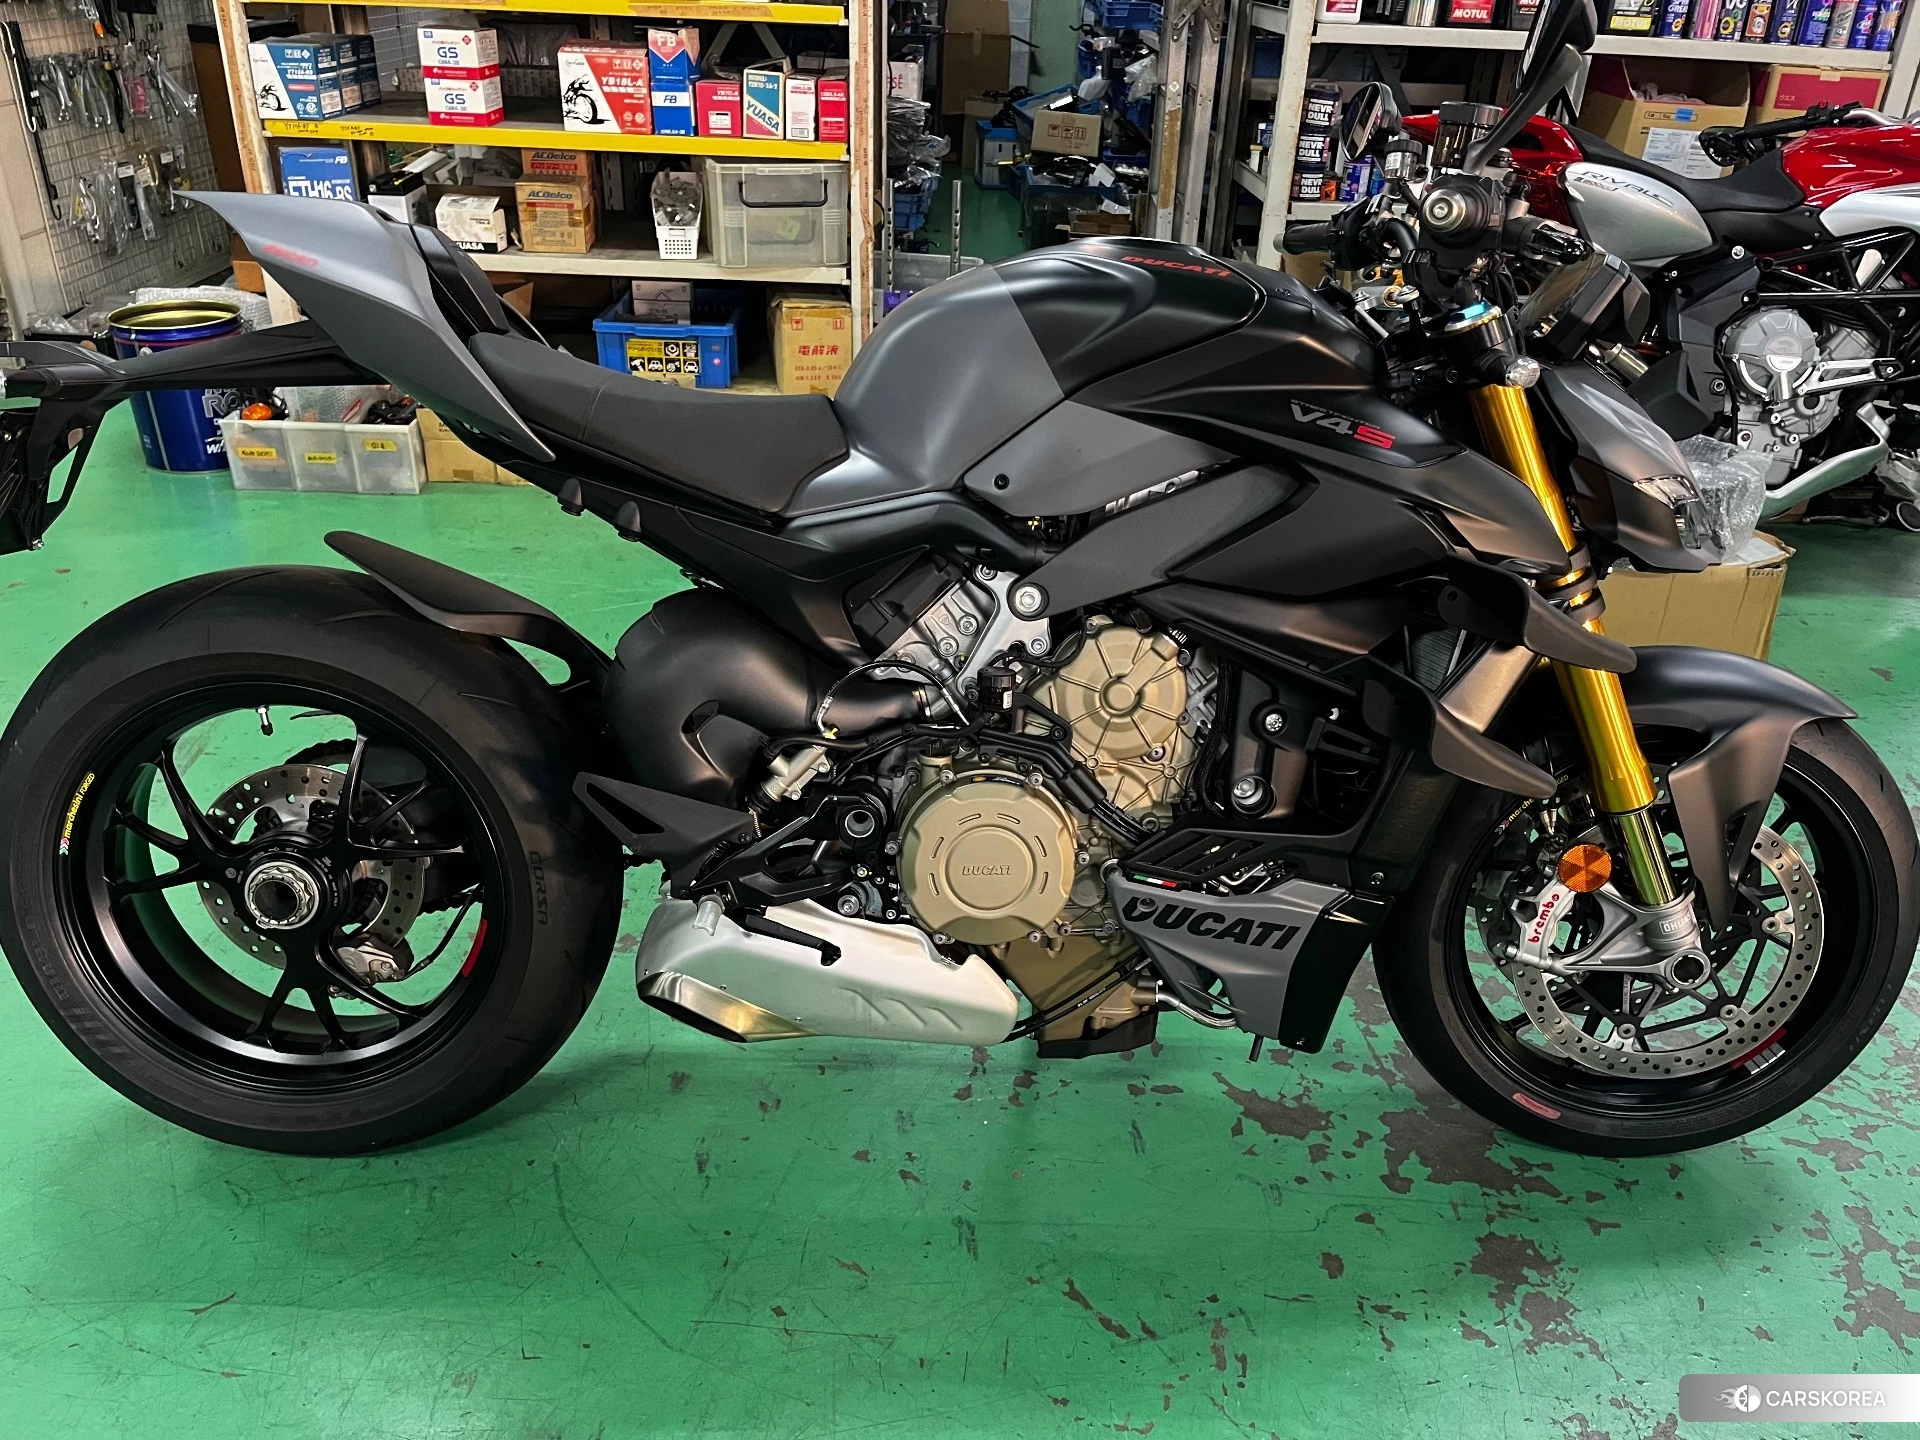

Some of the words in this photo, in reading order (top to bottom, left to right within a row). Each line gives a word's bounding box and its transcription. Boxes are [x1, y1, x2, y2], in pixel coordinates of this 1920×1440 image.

[1453, 9, 1488, 19] MOTUL
[657, 33, 676, 47] FB
[437, 46, 459, 59] GS
[444, 93, 466, 105] GS
[664, 95, 677, 103] FB
[746, 101, 780, 132] YUASA
[1307, 111, 1329, 121] DULL
[532, 151, 577, 160] ACDelco
[1298, 149, 1320, 157] DULL
[528, 190, 573, 199] ACDelco
[1120, 255, 1232, 277] DUCATI
[798, 345, 839, 356] 電解液
[1290, 403, 1396, 449] V4S
[64, 793, 84, 838] marchesini
[962, 865, 1012, 876] DUCATI
[529, 850, 548, 926] CORSA
[1121, 896, 1301, 950] DUCATI
[1528, 893, 1560, 944] brembo
